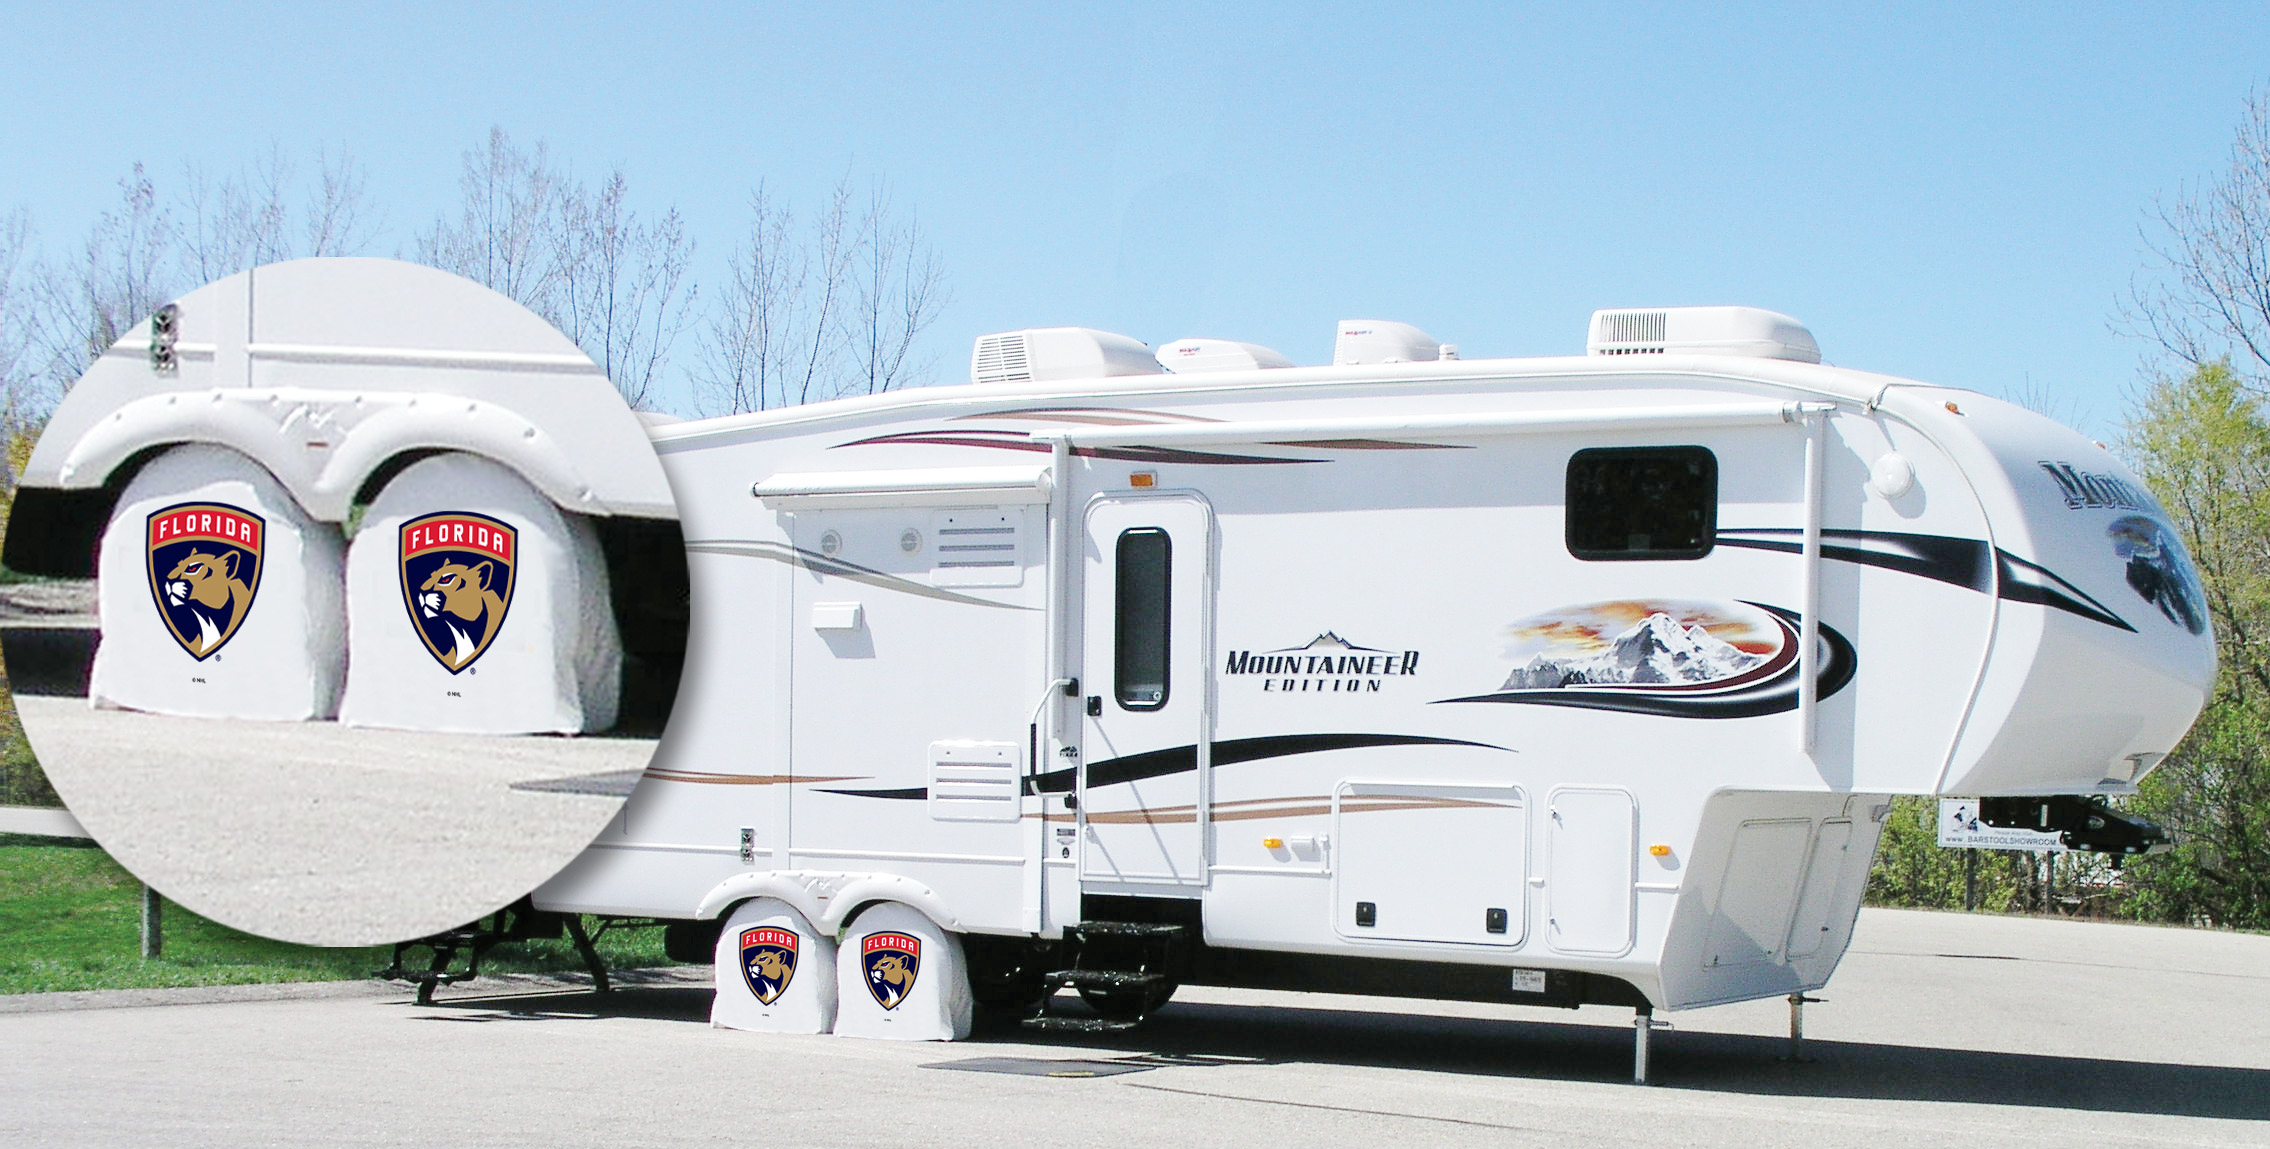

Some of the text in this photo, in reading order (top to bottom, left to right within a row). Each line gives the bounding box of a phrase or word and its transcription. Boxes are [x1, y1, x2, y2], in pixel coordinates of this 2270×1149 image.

[159, 513, 251, 543] FLORIDA
[412, 523, 503, 553] FLORIDA
[1225, 650, 1419, 676] MOUNTAINEER
[1263, 678, 1381, 692] EDITION
[745, 931, 792, 947] FLORIDA
[867, 936, 914, 952] FLORIDA
